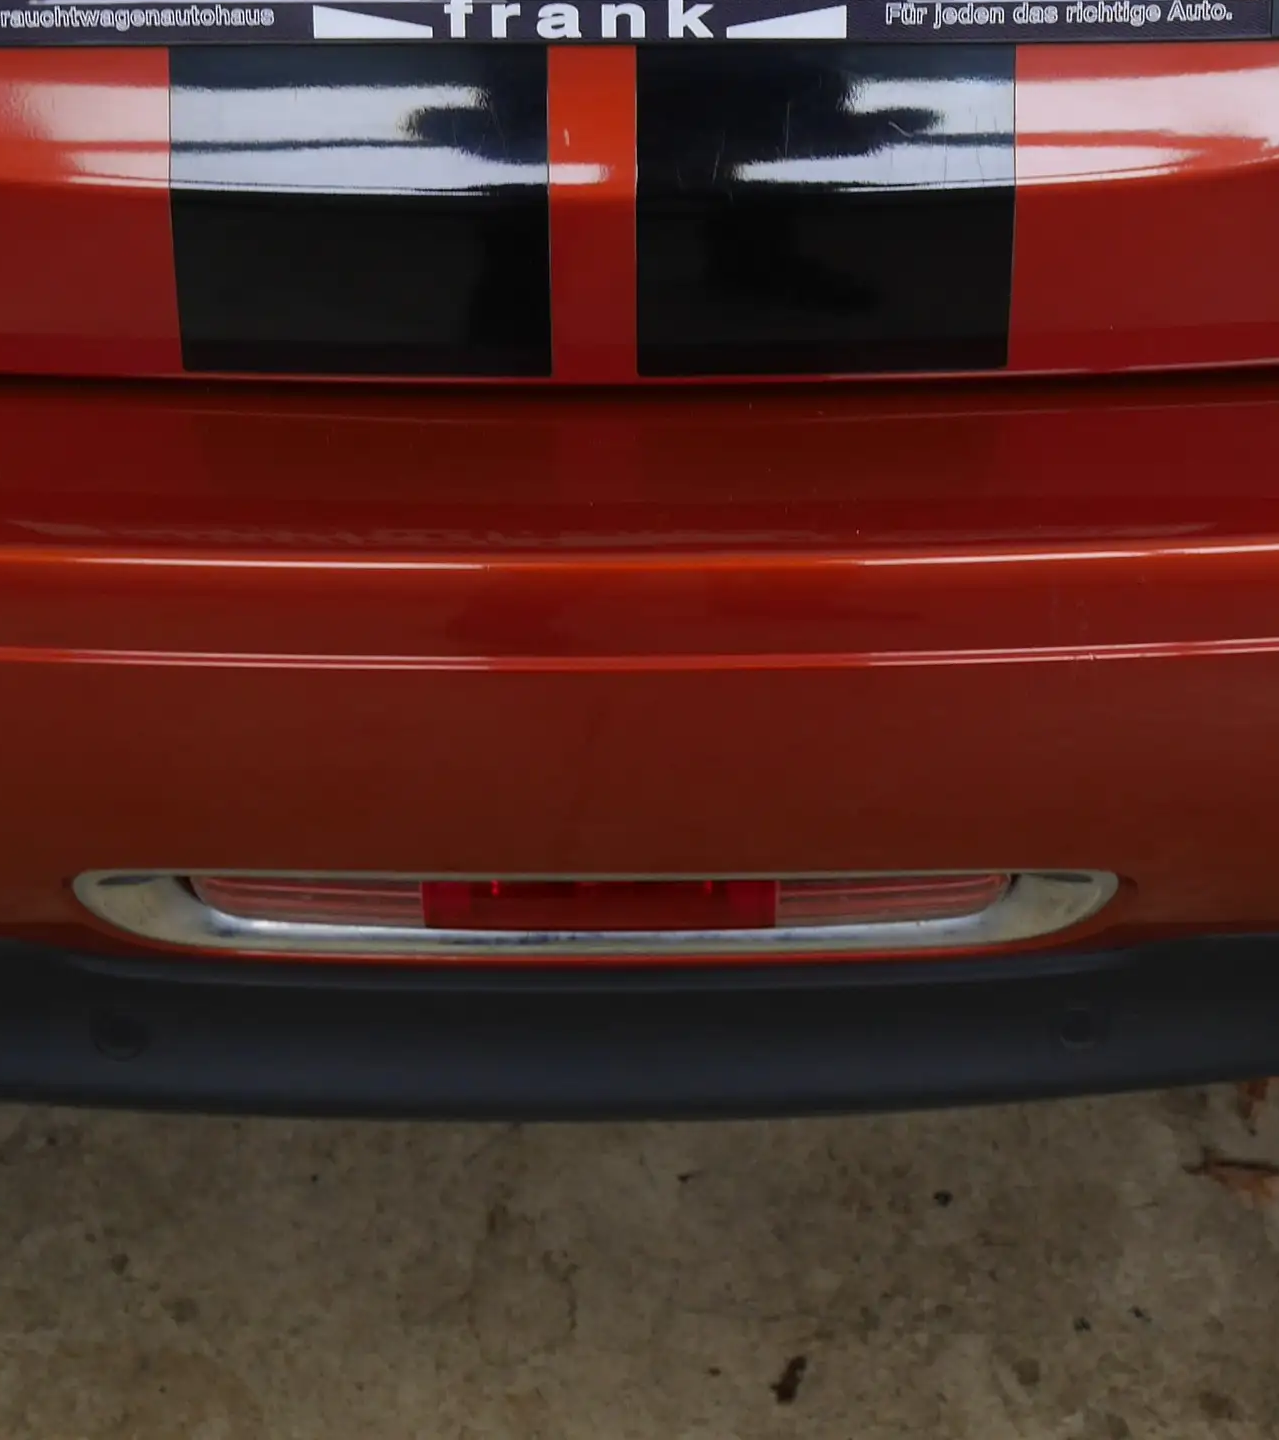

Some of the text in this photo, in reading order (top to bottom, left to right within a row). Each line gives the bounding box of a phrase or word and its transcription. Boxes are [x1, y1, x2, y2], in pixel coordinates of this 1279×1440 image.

[885, 0, 1234, 29] Für jeden das richtige Auto.
